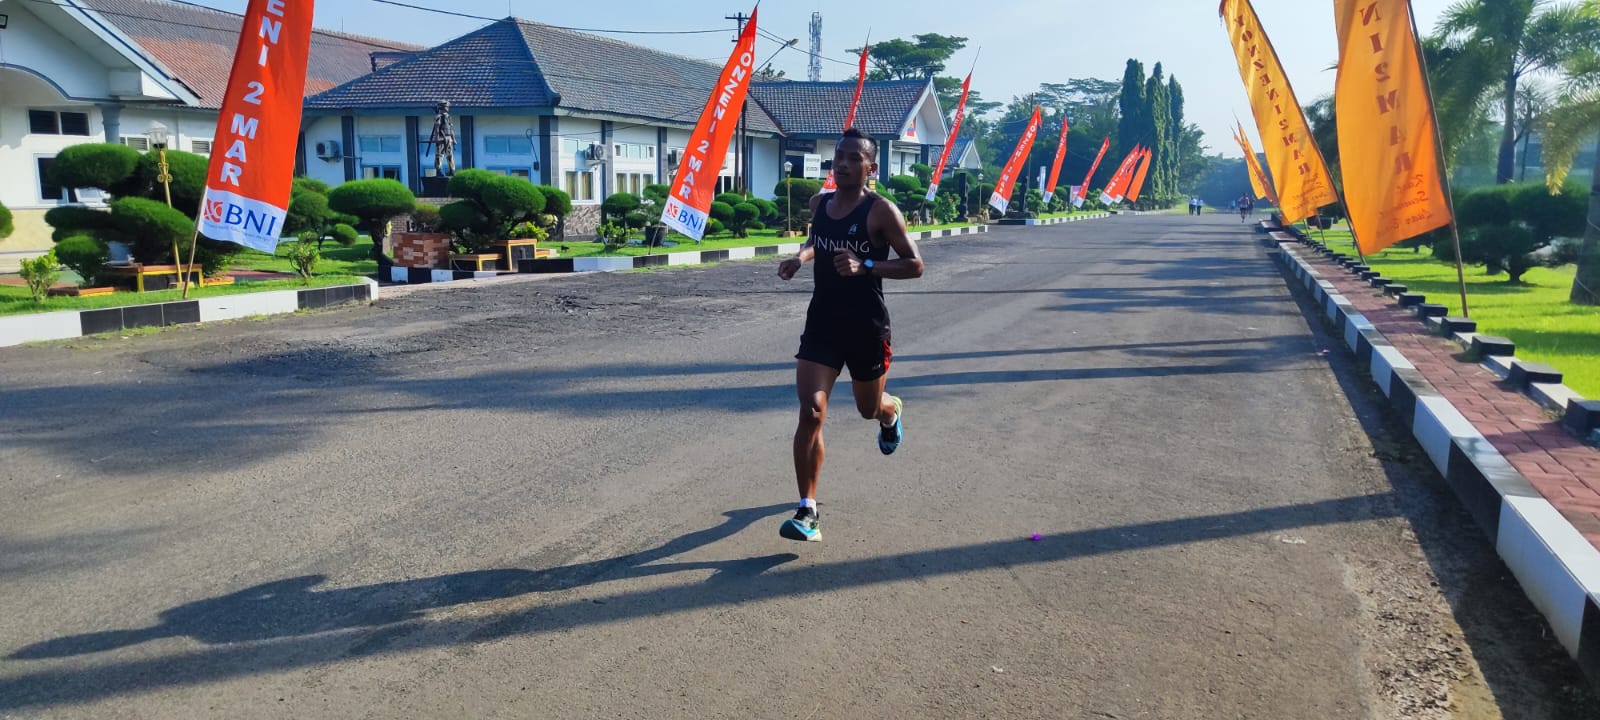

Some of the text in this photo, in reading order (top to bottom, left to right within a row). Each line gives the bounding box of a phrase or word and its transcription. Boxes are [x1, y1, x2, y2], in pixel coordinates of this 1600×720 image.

[243, 81, 264, 105] 2
[709, 41, 753, 133] ONZENI
[220, 114, 259, 187] MAR
[697, 139, 710, 155] 2
[679, 155, 702, 200] MAR
[224, 203, 277, 236] BNI
[678, 209, 704, 231] BNI
